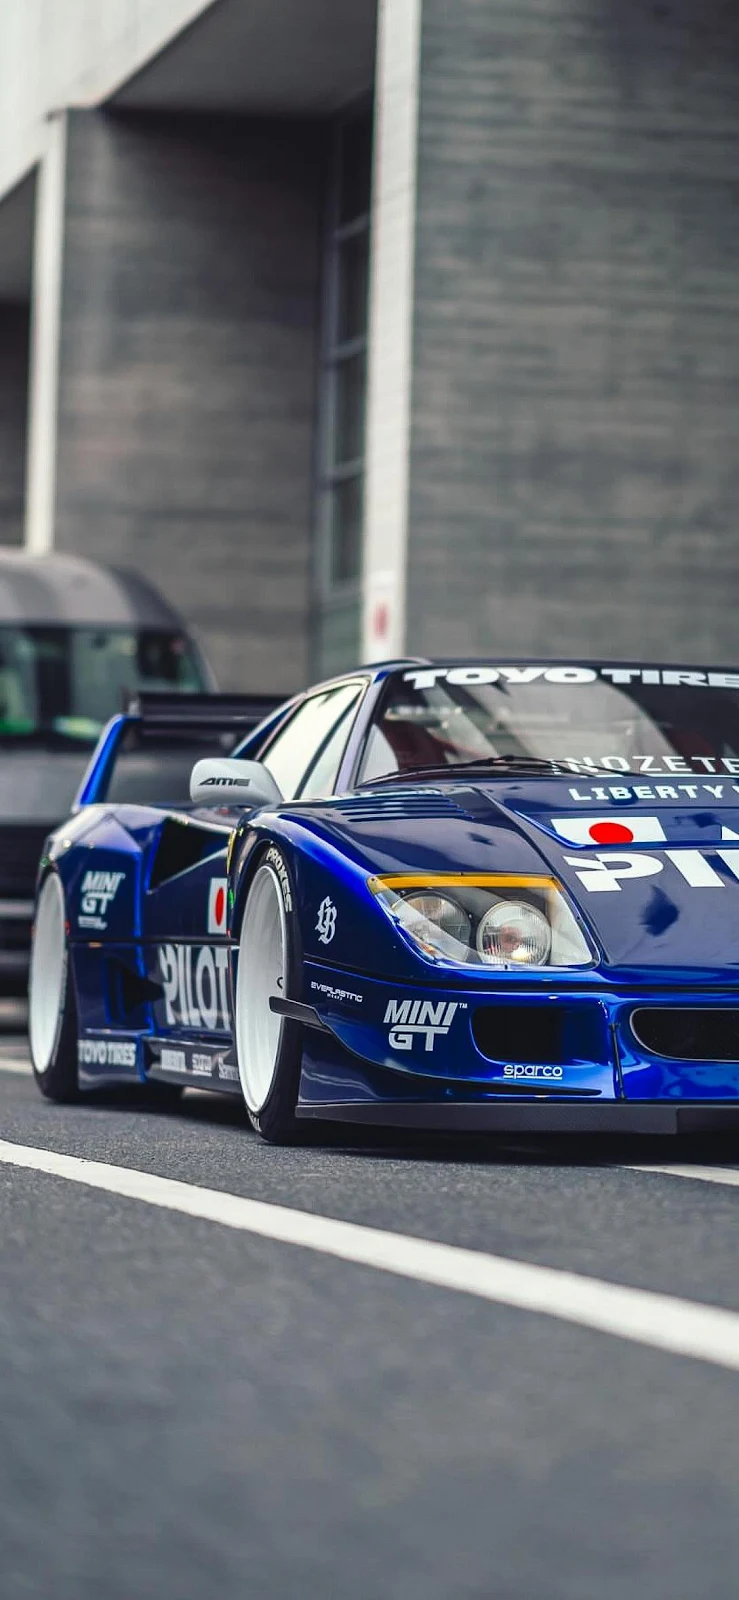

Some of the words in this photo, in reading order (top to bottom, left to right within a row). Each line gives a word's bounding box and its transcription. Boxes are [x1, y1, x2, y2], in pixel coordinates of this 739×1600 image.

[403, 667, 597, 690] TOYO
[568, 785, 725, 801] LIBERTY
[265, 848, 293, 912] PROXES
[562, 849, 739, 892] PI
[82, 892, 115, 915] GT
[158, 944, 231, 1032] PILOT
[388, 1024, 450, 1051] GT
[503, 1064, 563, 1080] sparco
